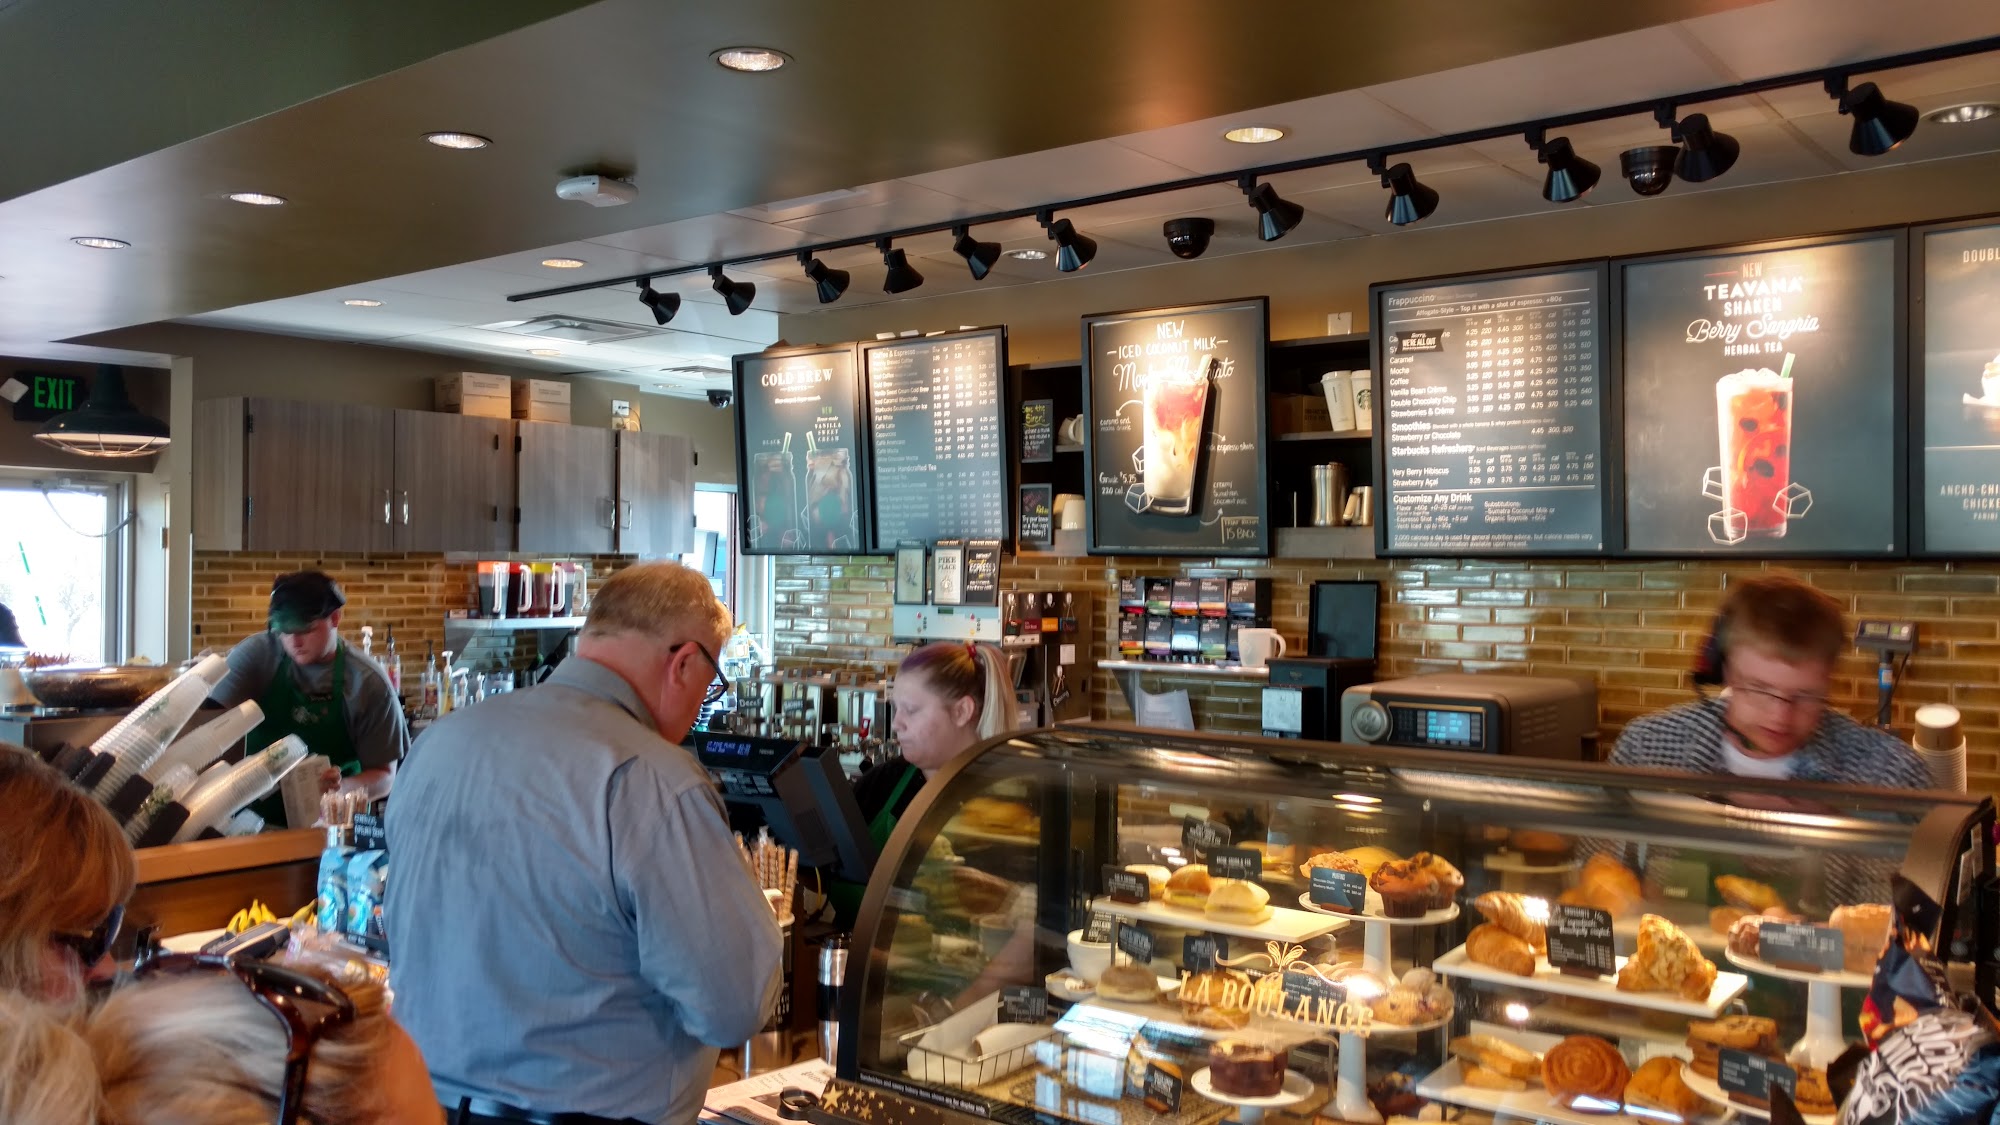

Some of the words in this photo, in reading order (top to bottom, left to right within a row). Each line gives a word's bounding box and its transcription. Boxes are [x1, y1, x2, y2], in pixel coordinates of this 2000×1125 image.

[1742, 262, 1762, 278] NEW
[1704, 276, 1802, 301] TEAVANA
[1389, 294, 1436, 307] Frappuccino
[1724, 297, 1782, 317] SHAKEN
[1157, 320, 1185, 340] NEW
[1686, 319, 1742, 344] Berry
[1747, 313, 1819, 340] Sangria
[1119, 346, 1141, 360] ICED
[1146, 340, 1189, 356] COCONUT
[1194, 336, 1217, 352] MILK
[1417, 338, 1426, 346] ALL
[1724, 343, 1761, 356] HERBAL
[1764, 341, 1782, 353] TEA
[1390, 356, 1414, 364] Caramel
[1390, 367, 1410, 375] Mocha
[761, 373, 793, 388] COLD
[795, 368, 833, 384] BREW
[1390, 378, 1409, 386] Coffee
[34, 376, 75, 411] EXIT
[1390, 388, 1409, 396] Vanilla
[1410, 387, 1426, 395] Bean
[1391, 399, 1412, 407] Double
[1442, 395, 1458, 405] Chip
[822, 405, 833, 415] NEW
[1391, 409, 1427, 418] Strawberries
[814, 422, 842, 430] VANILLA
[1392, 422, 1431, 432] Smoothies
[1392, 433, 1423, 443] Strawberry
[1423, 433, 1431, 441] or
[1431, 431, 1461, 441] Chocolate
[1392, 446, 1430, 457] Starbucks
[1392, 468, 1406, 477] Very
[1406, 467, 1423, 477] Berry
[1423, 466, 1450, 476] Hibiscus
[1392, 477, 1424, 488] Strawberry
[1393, 494, 1432, 504] Customize
[1434, 494, 1449, 504] Any
[1450, 492, 1472, 503] Drink
[938, 556, 957, 564] PIKE
[1176, 969, 1212, 1006] LA
[1219, 976, 1374, 1039] BOULANGE
